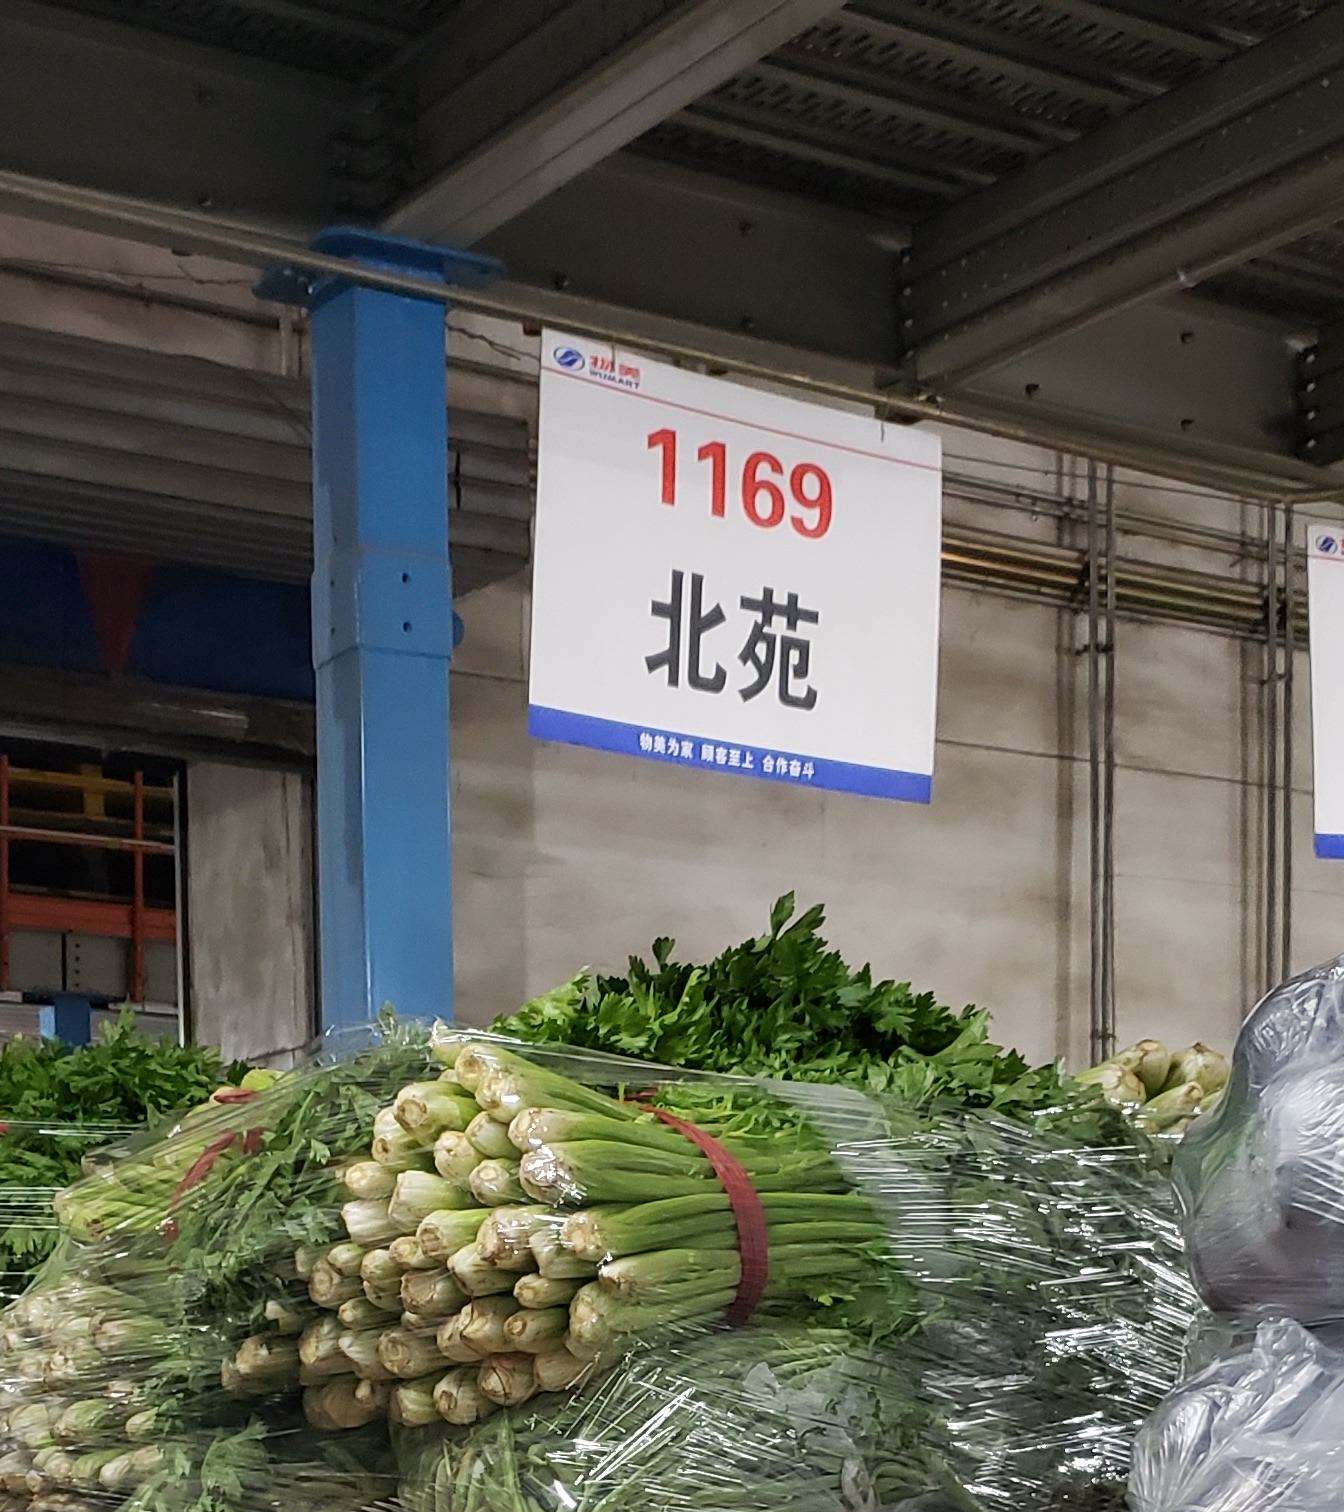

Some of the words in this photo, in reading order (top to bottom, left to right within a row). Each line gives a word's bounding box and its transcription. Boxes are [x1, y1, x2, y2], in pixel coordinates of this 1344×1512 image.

[647, 427, 833, 540] 1169
[644, 568, 820, 711] 北苑
[639, 732, 694, 759] 物美为家
[700, 744, 754, 769] 顾客至上
[762, 754, 815, 780] 合作奋斗
